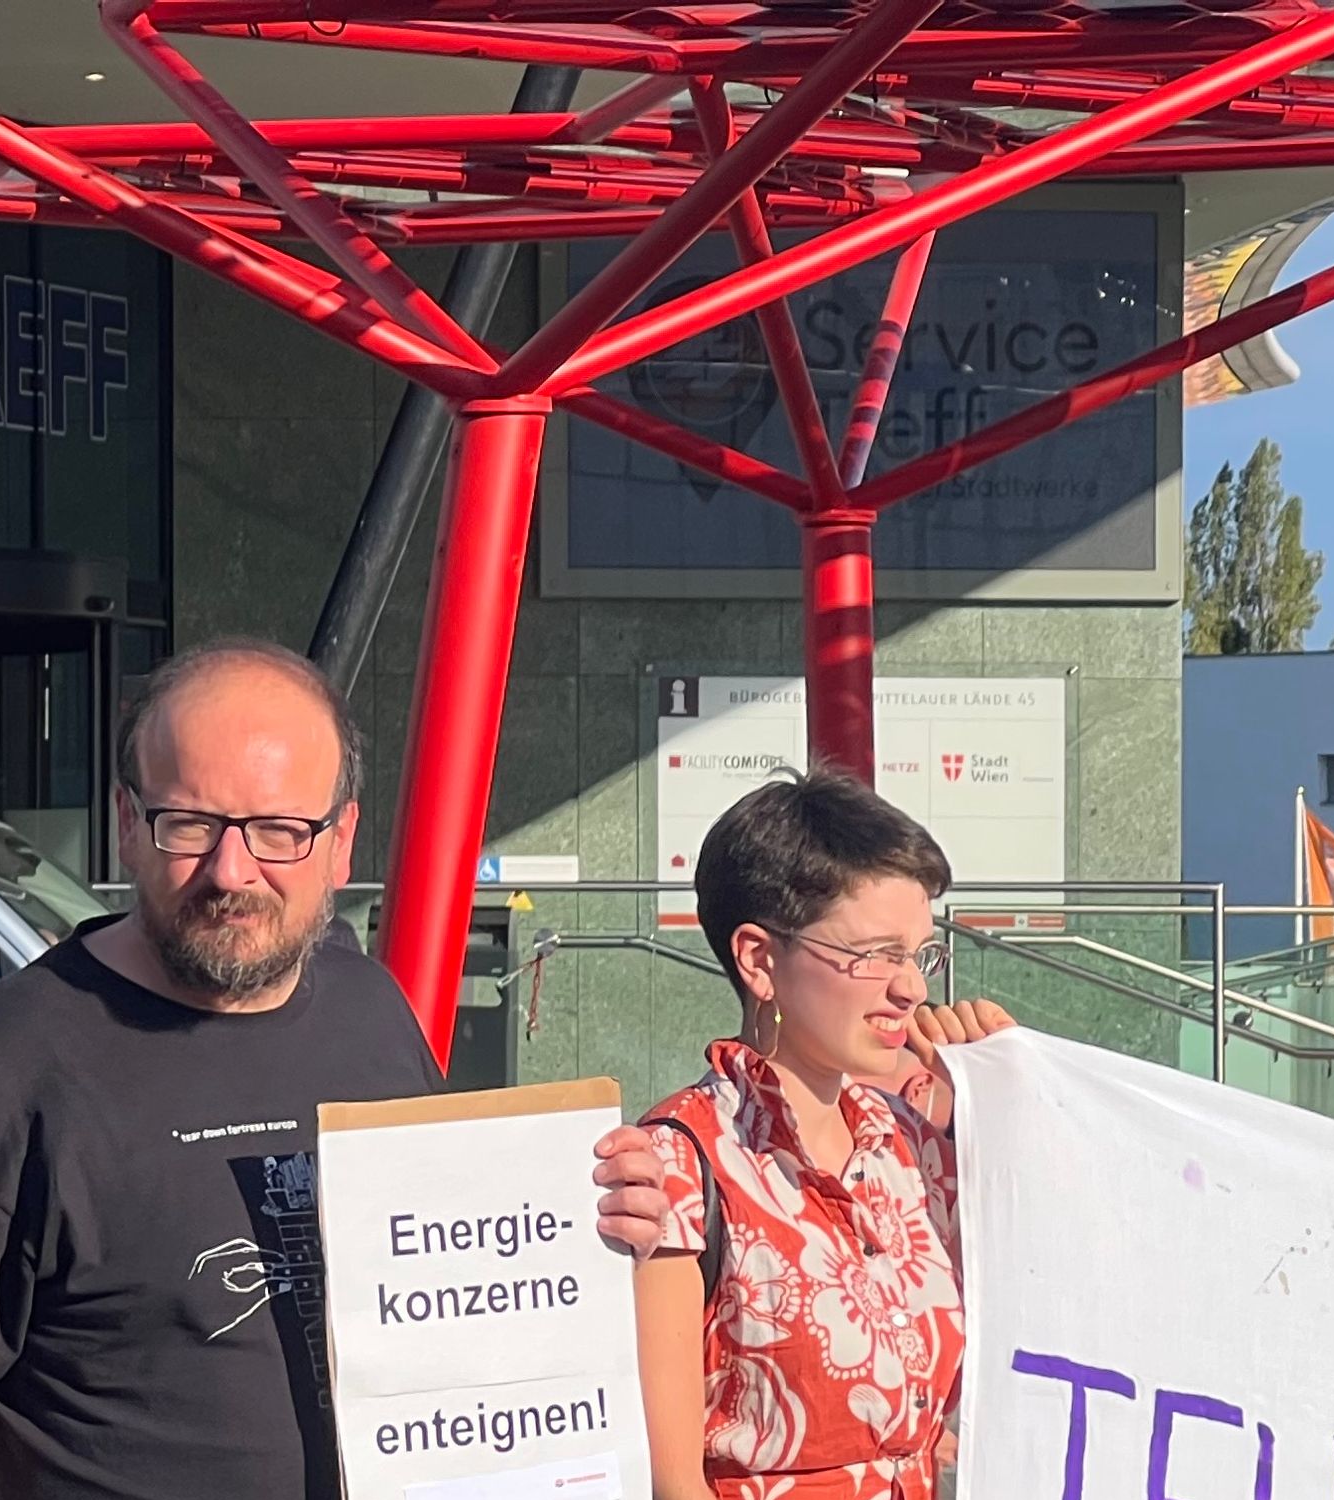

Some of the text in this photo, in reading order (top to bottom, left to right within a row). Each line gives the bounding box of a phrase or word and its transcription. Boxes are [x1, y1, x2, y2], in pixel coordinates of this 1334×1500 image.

[963, 691, 1012, 706] LÄNDE
[1017, 692, 1036, 706] 45
[882, 762, 920, 773] NETZE
[971, 754, 1009, 768] Stadt
[971, 769, 1009, 783] Wien
[389, 1202, 574, 1257] Energie-
[377, 1272, 580, 1325] konzerne
[375, 1388, 609, 1455] enteignen!
